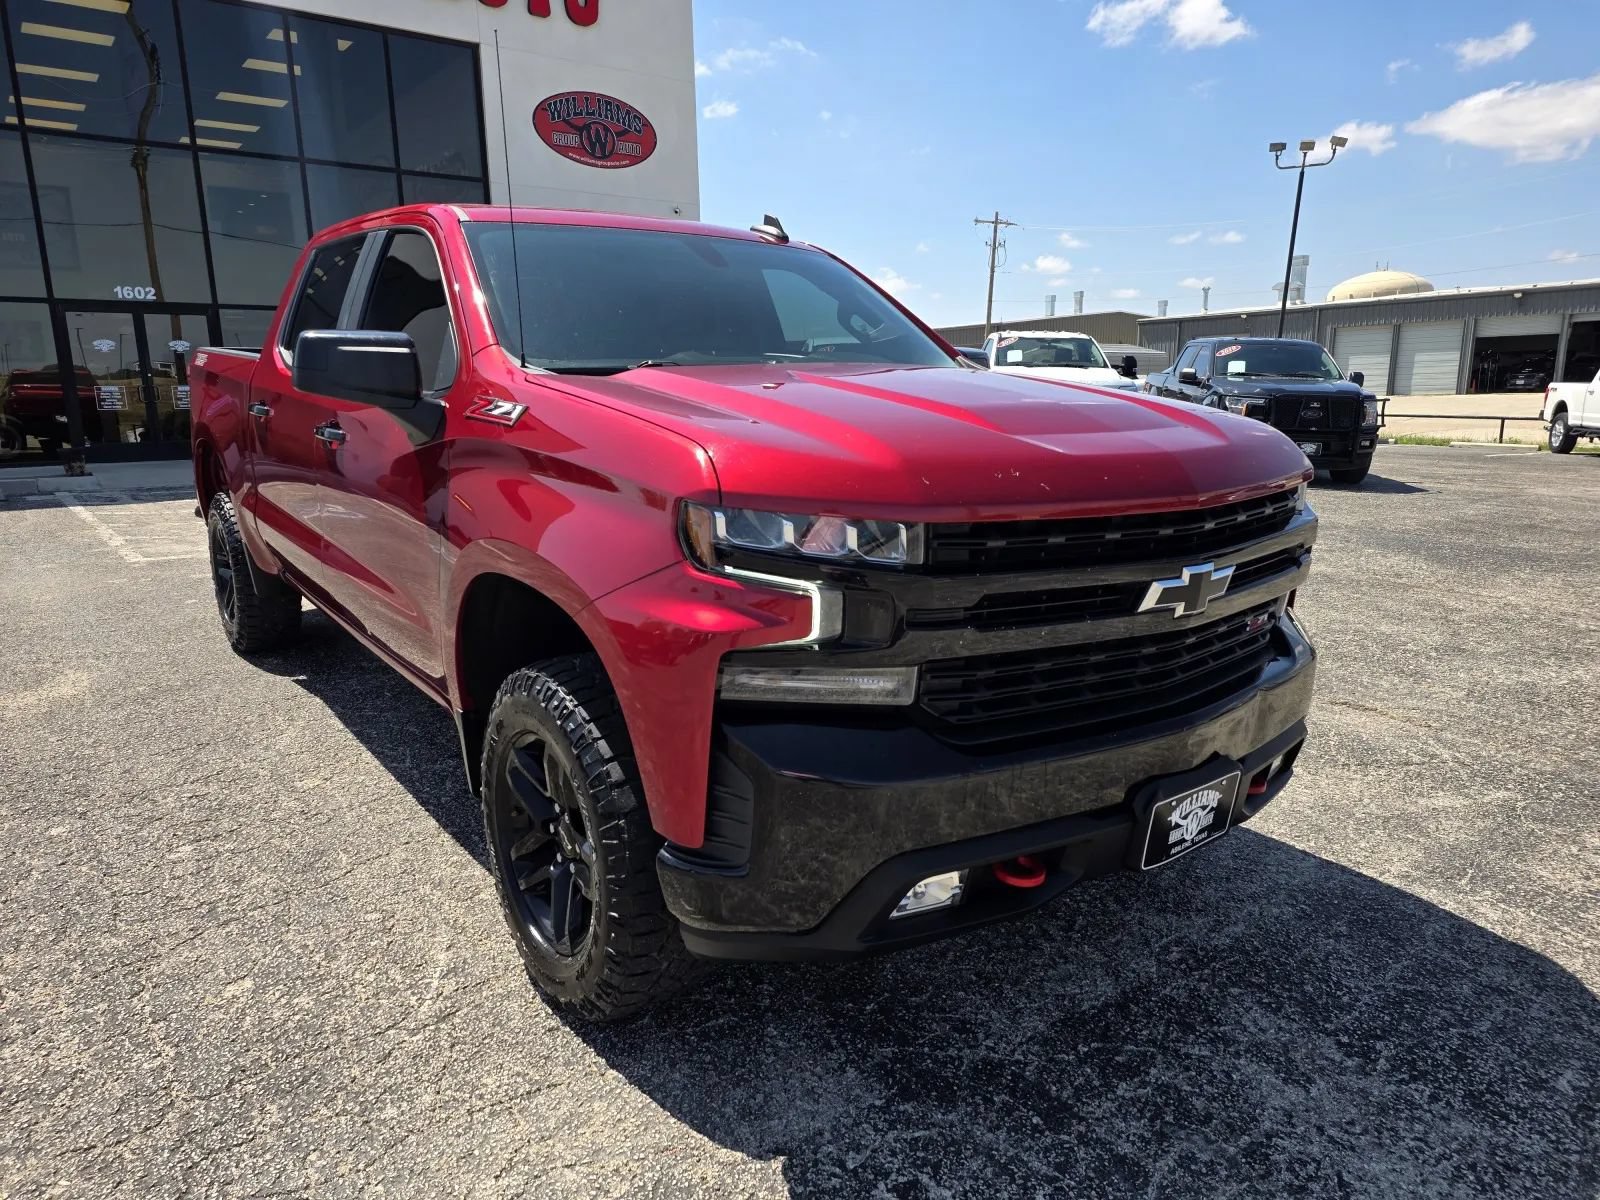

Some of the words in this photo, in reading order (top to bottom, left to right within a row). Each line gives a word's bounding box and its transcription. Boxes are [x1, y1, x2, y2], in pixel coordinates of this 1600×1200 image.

[547, 96, 643, 136] WILLIAMS
[552, 132, 580, 147] GROUP
[583, 121, 612, 159] W
[618, 141, 642, 156] AUTO
[113, 286, 157, 300] 1602
[463, 395, 529, 426] Z71
